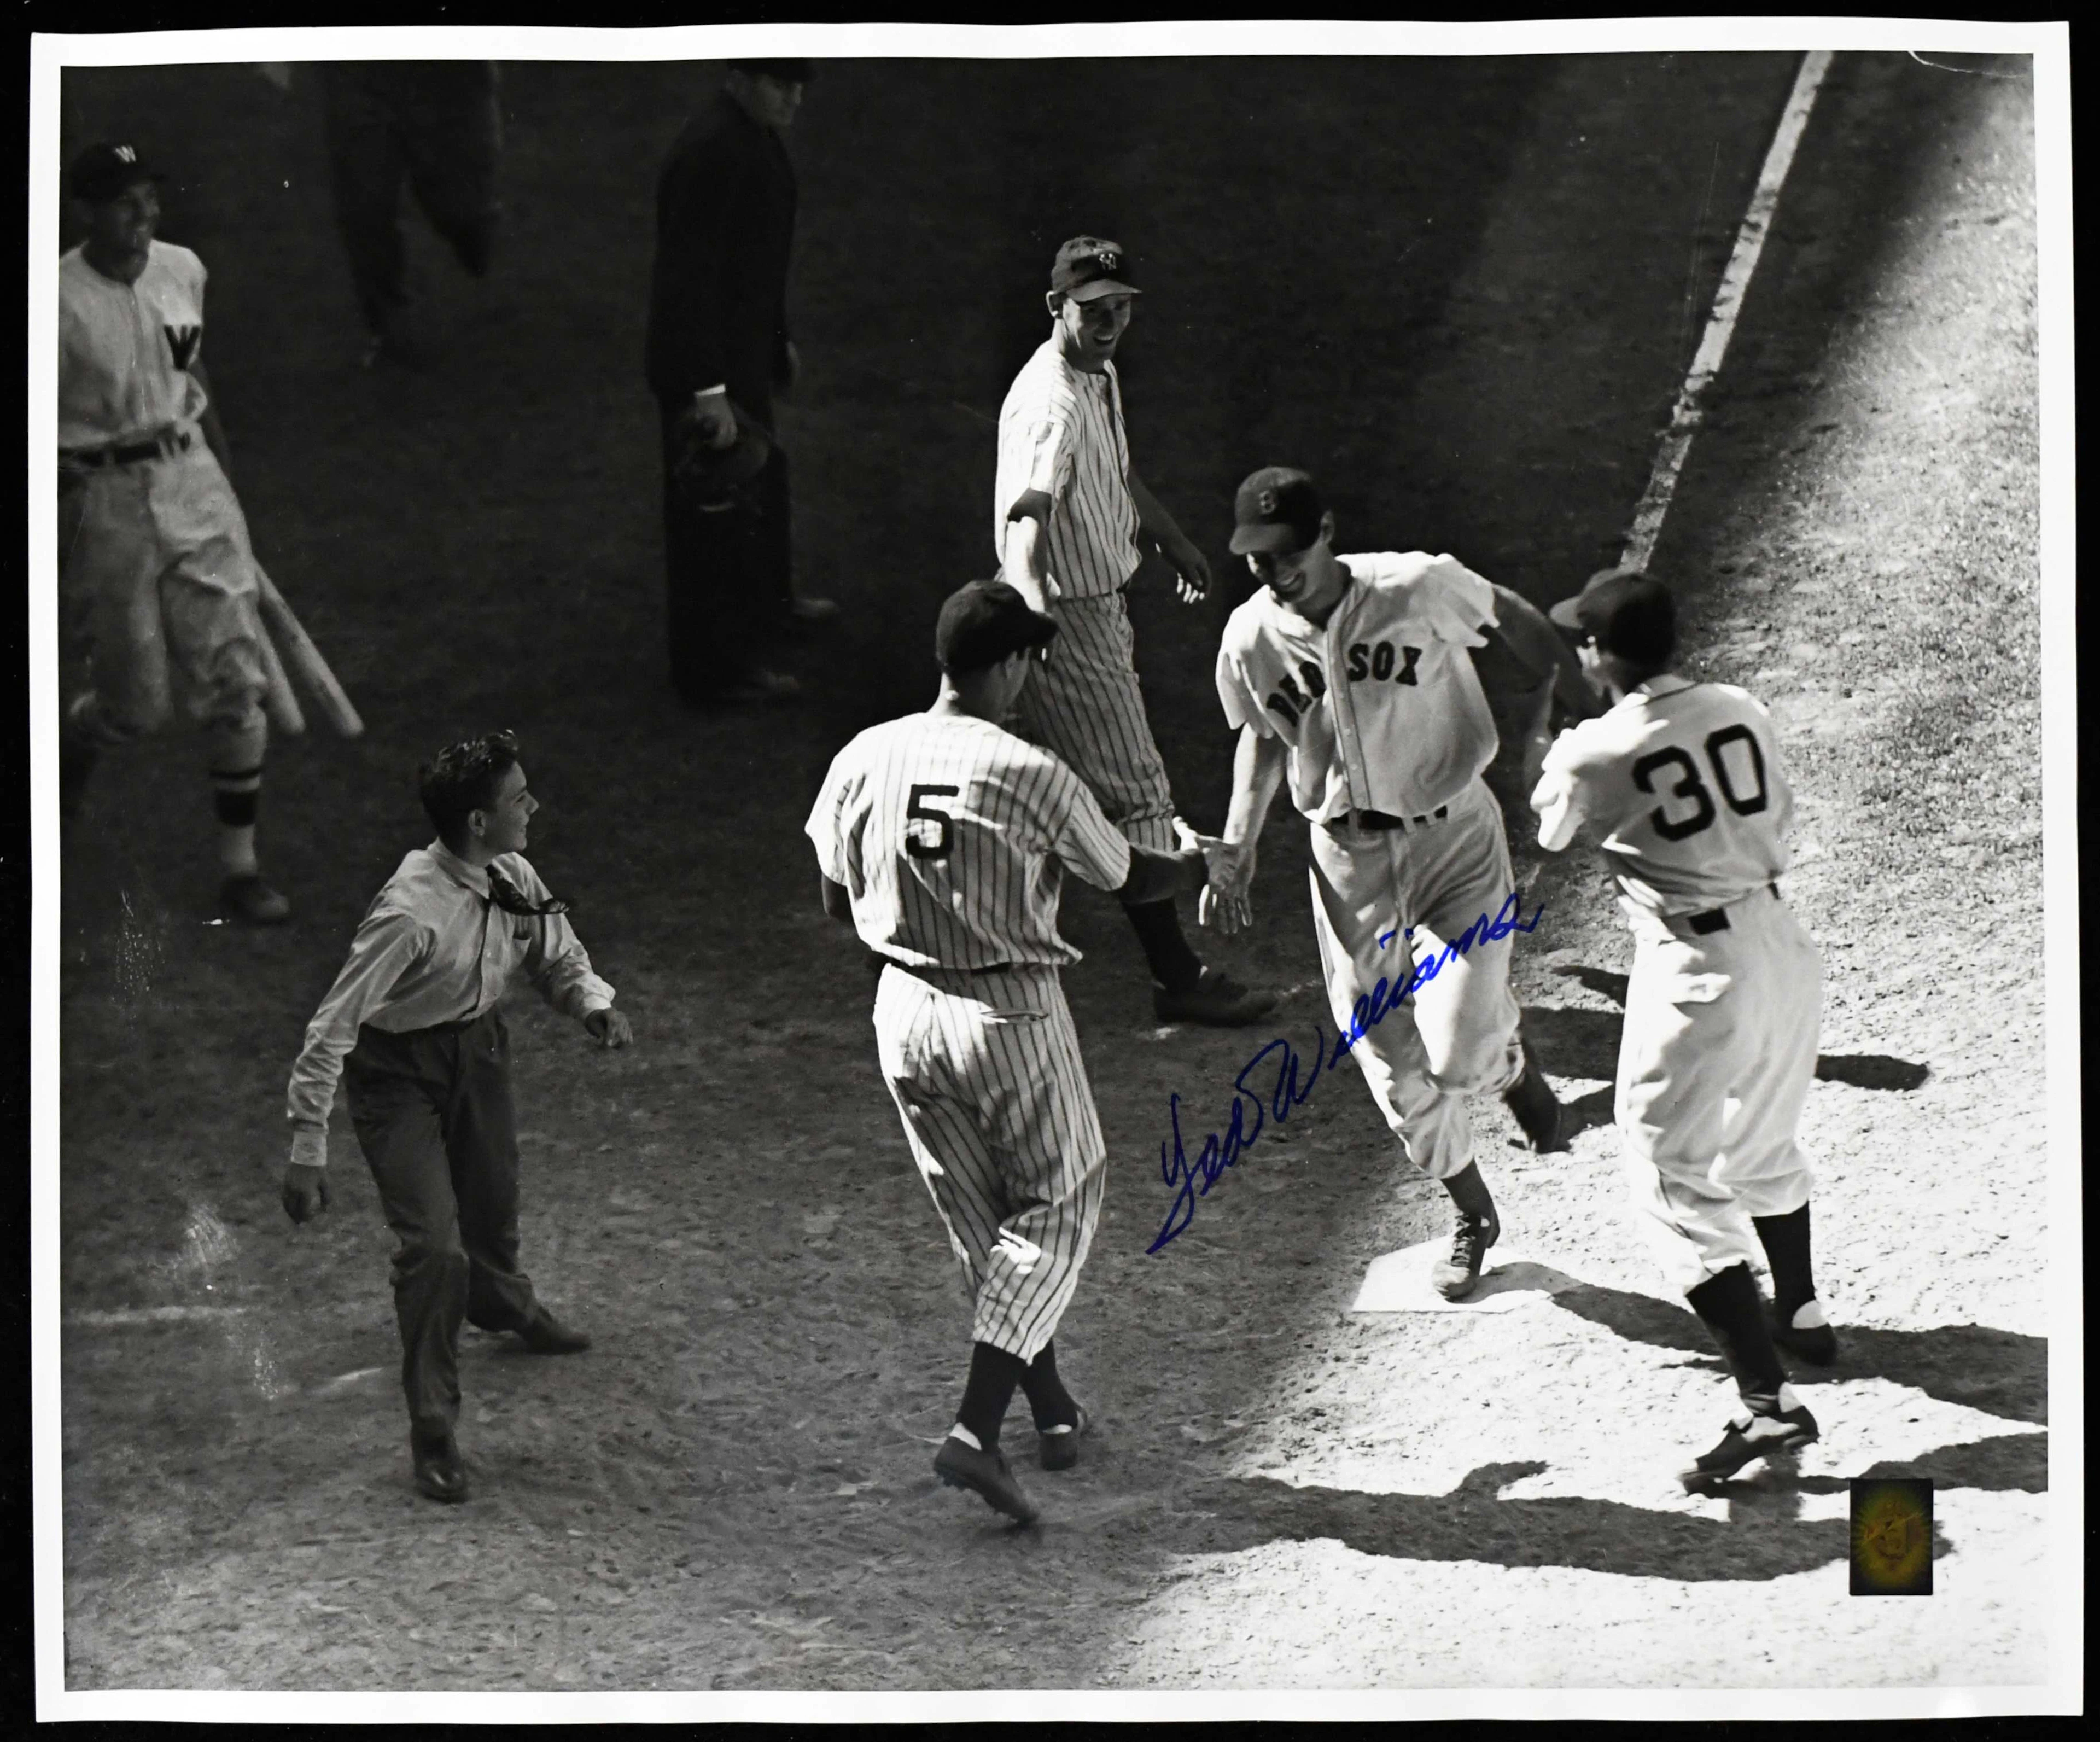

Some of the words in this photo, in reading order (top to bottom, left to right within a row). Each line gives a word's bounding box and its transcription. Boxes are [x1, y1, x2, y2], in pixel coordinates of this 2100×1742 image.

[115, 145, 137, 162] W
[1259, 490, 1276, 514] B
[1348, 640, 1423, 686] SOX
[1631, 723, 1768, 842] 30
[905, 783, 960, 860] 5
